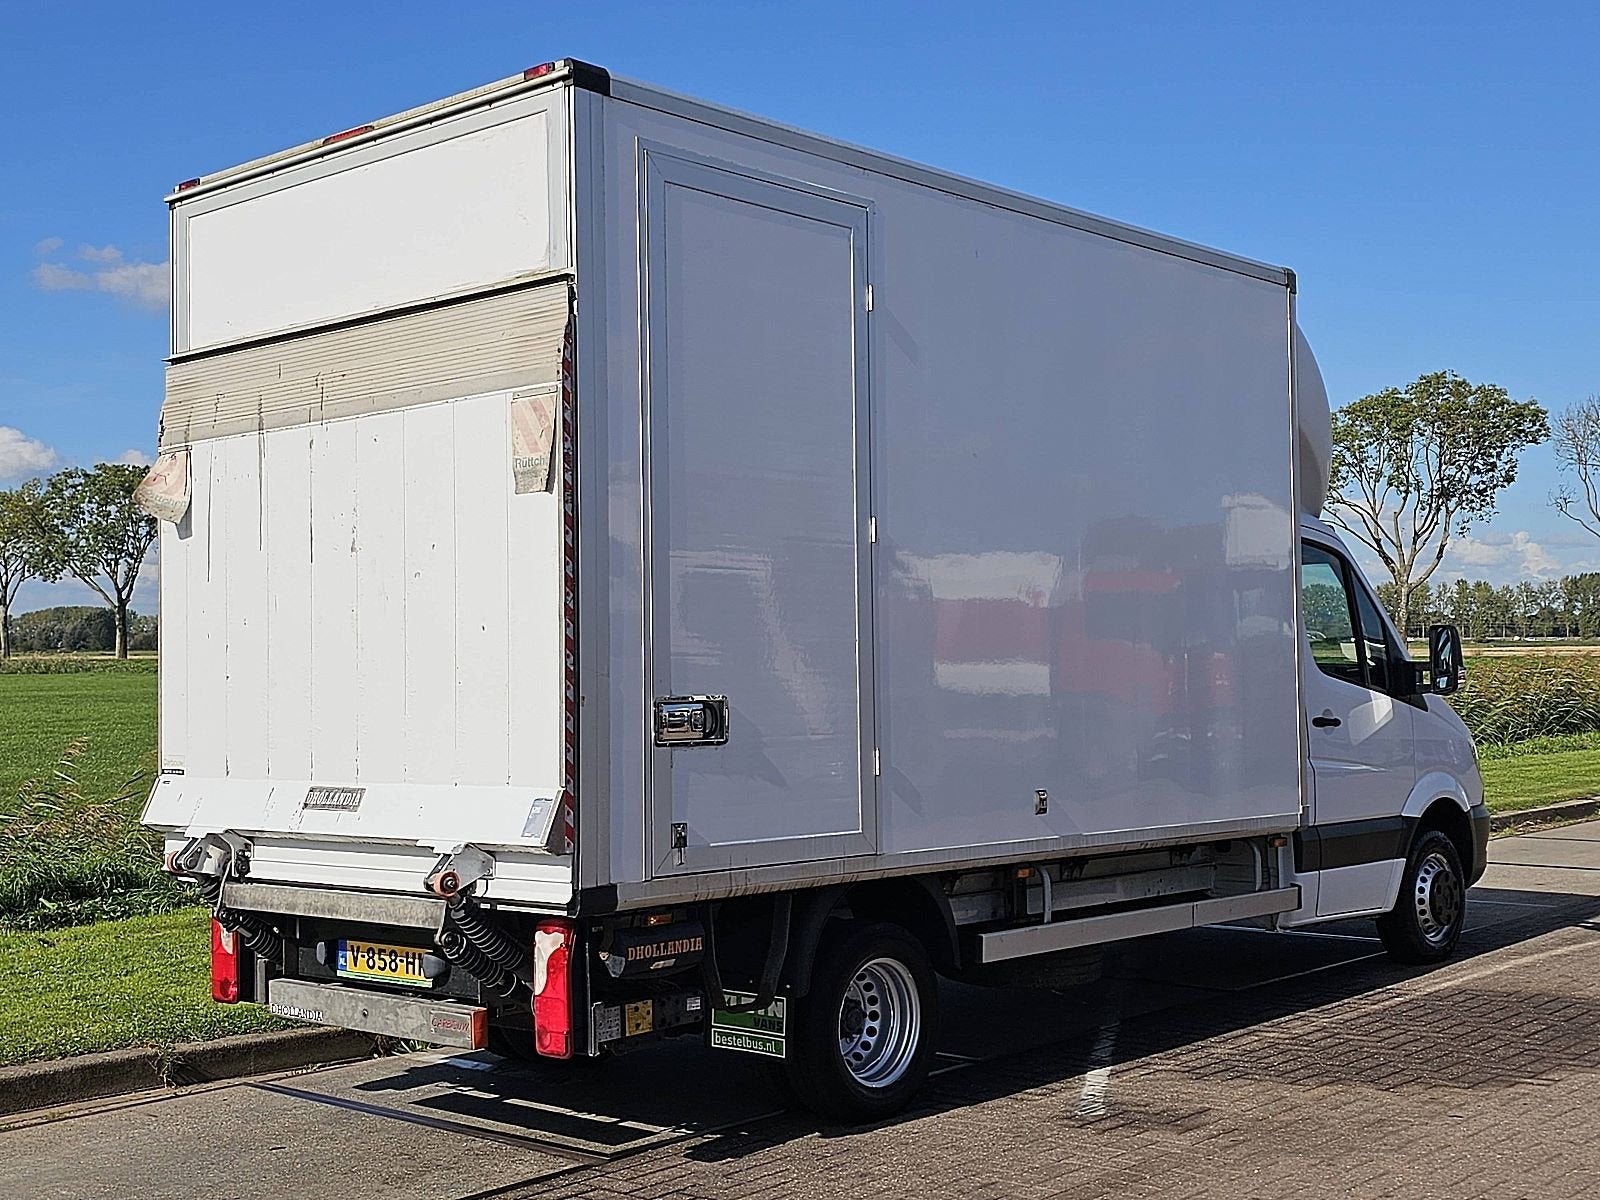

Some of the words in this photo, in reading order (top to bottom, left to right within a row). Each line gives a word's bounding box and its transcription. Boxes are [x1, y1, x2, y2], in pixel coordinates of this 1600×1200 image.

[305, 789, 362, 806] DHOLLANDIA
[627, 937, 703, 961] DHOLLANDIA
[270, 1003, 324, 1022] DHOLLANDIA
[752, 1017, 784, 1032] VANS
[715, 1032, 776, 1053] bestelbus.nl
